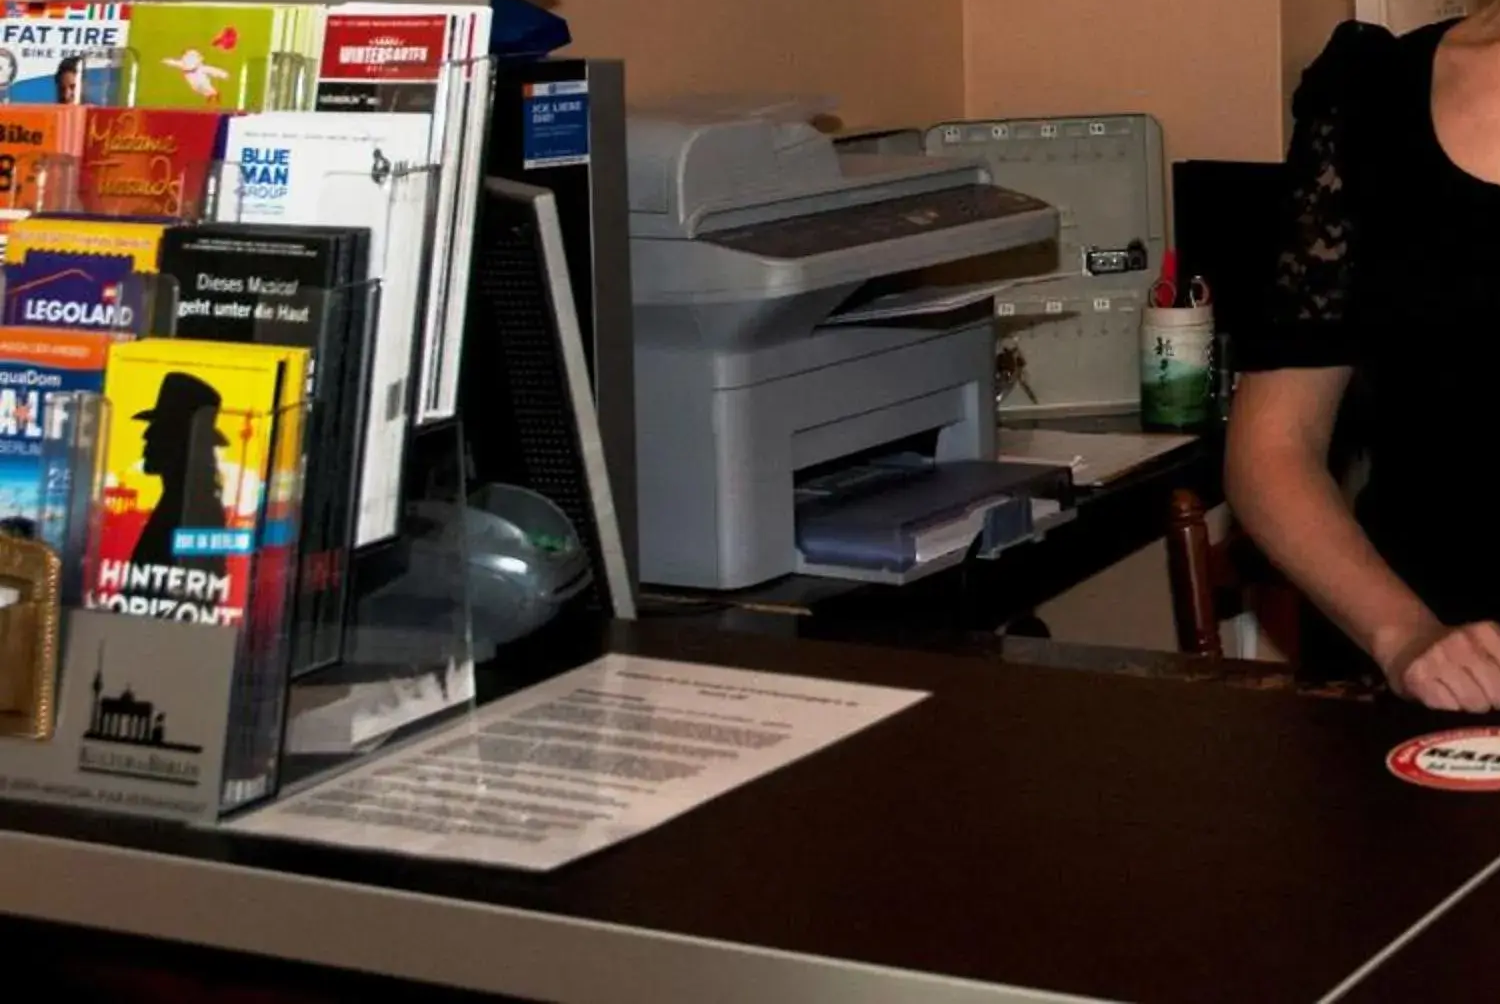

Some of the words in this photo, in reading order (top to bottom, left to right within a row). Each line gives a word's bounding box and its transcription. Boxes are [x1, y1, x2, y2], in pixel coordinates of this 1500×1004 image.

[4, 25, 52, 44] FAT
[59, 27, 119, 46] TIRE
[241, 147, 291, 166] BLUE
[241, 165, 289, 185] MAN
[236, 184, 289, 199] GROUP
[196, 272, 244, 293] Dieses
[25, 299, 134, 326] LEGOLAND
[177, 299, 211, 318] geht
[214, 301, 251, 318] unter
[277, 304, 310, 322] Haut
[0, 369, 62, 387] quaDom
[99, 558, 233, 603] HINTERM
